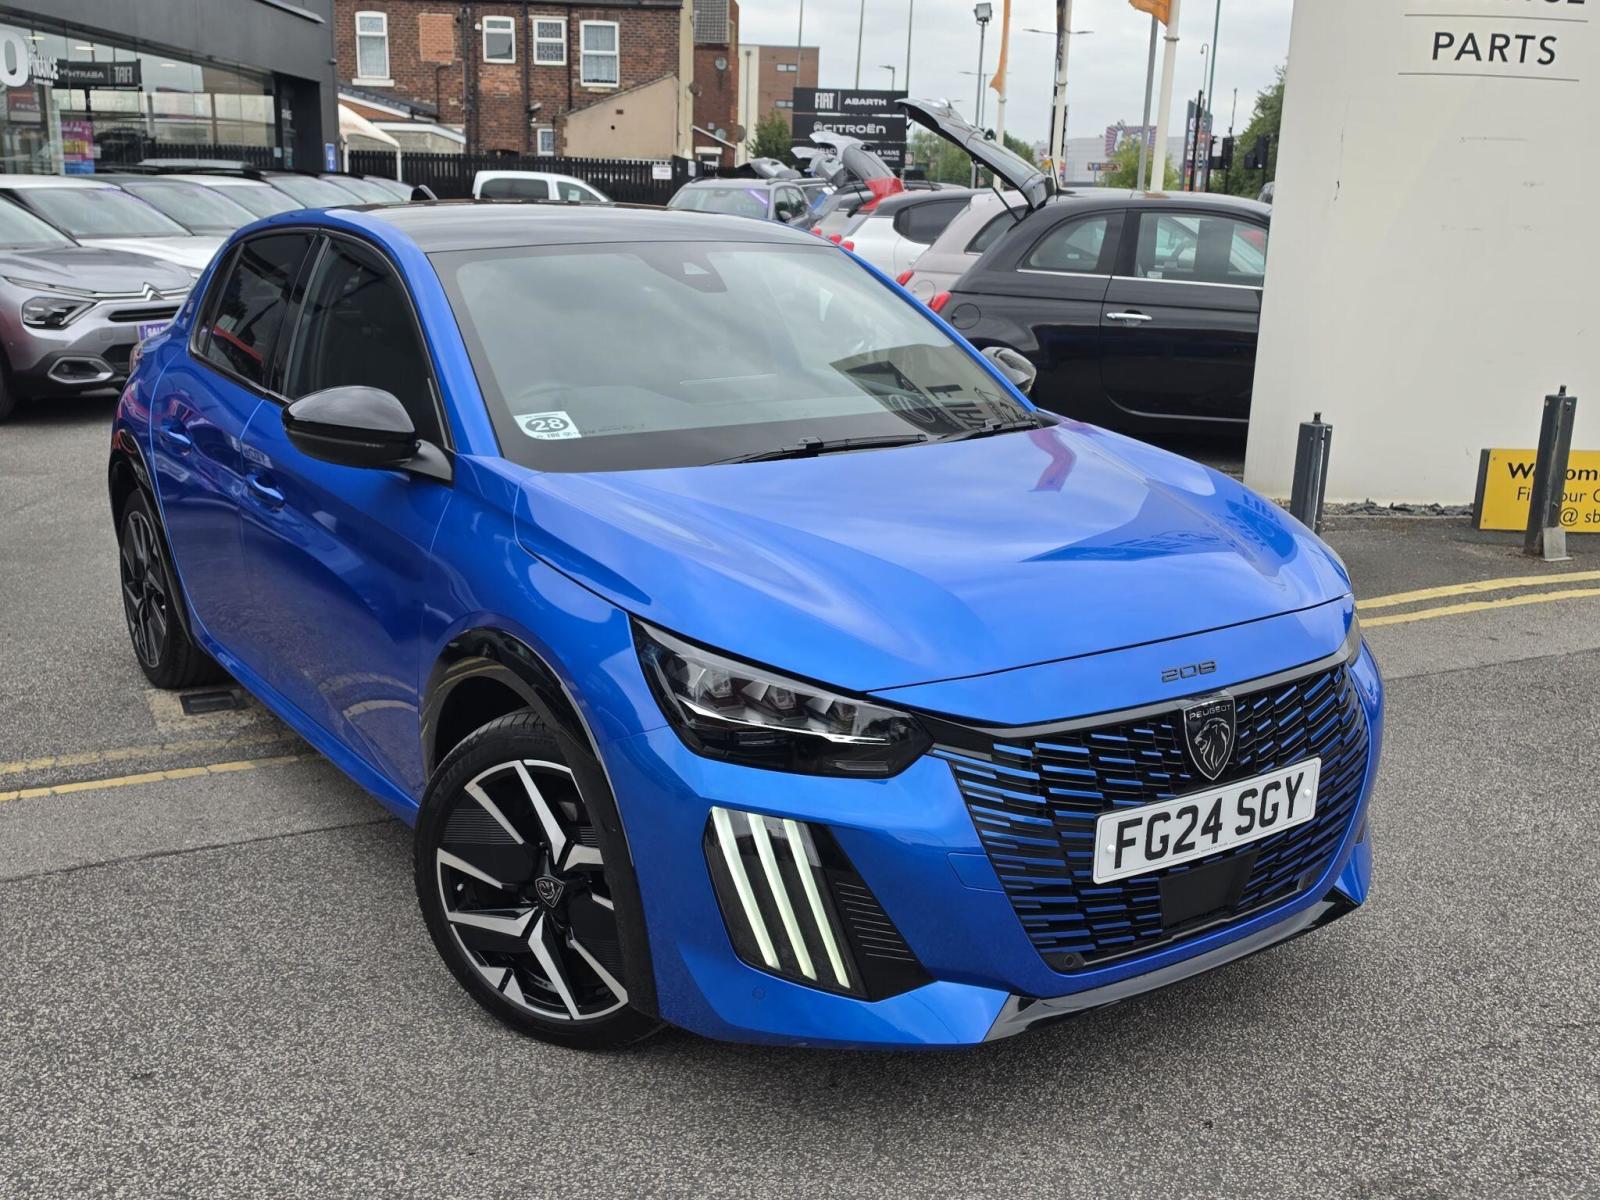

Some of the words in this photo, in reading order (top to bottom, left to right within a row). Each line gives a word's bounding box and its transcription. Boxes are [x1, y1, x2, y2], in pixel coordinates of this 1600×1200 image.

[1432, 32, 1557, 65] PARTS
[815, 92, 835, 109] FIAT
[844, 98, 887, 106] ABARTH
[531, 418, 565, 431] 28
[1161, 661, 1216, 683] 208
[1189, 704, 1231, 720] PEUGEOT
[1114, 797, 1223, 869] FG24
[1235, 772, 1304, 836] SGY
